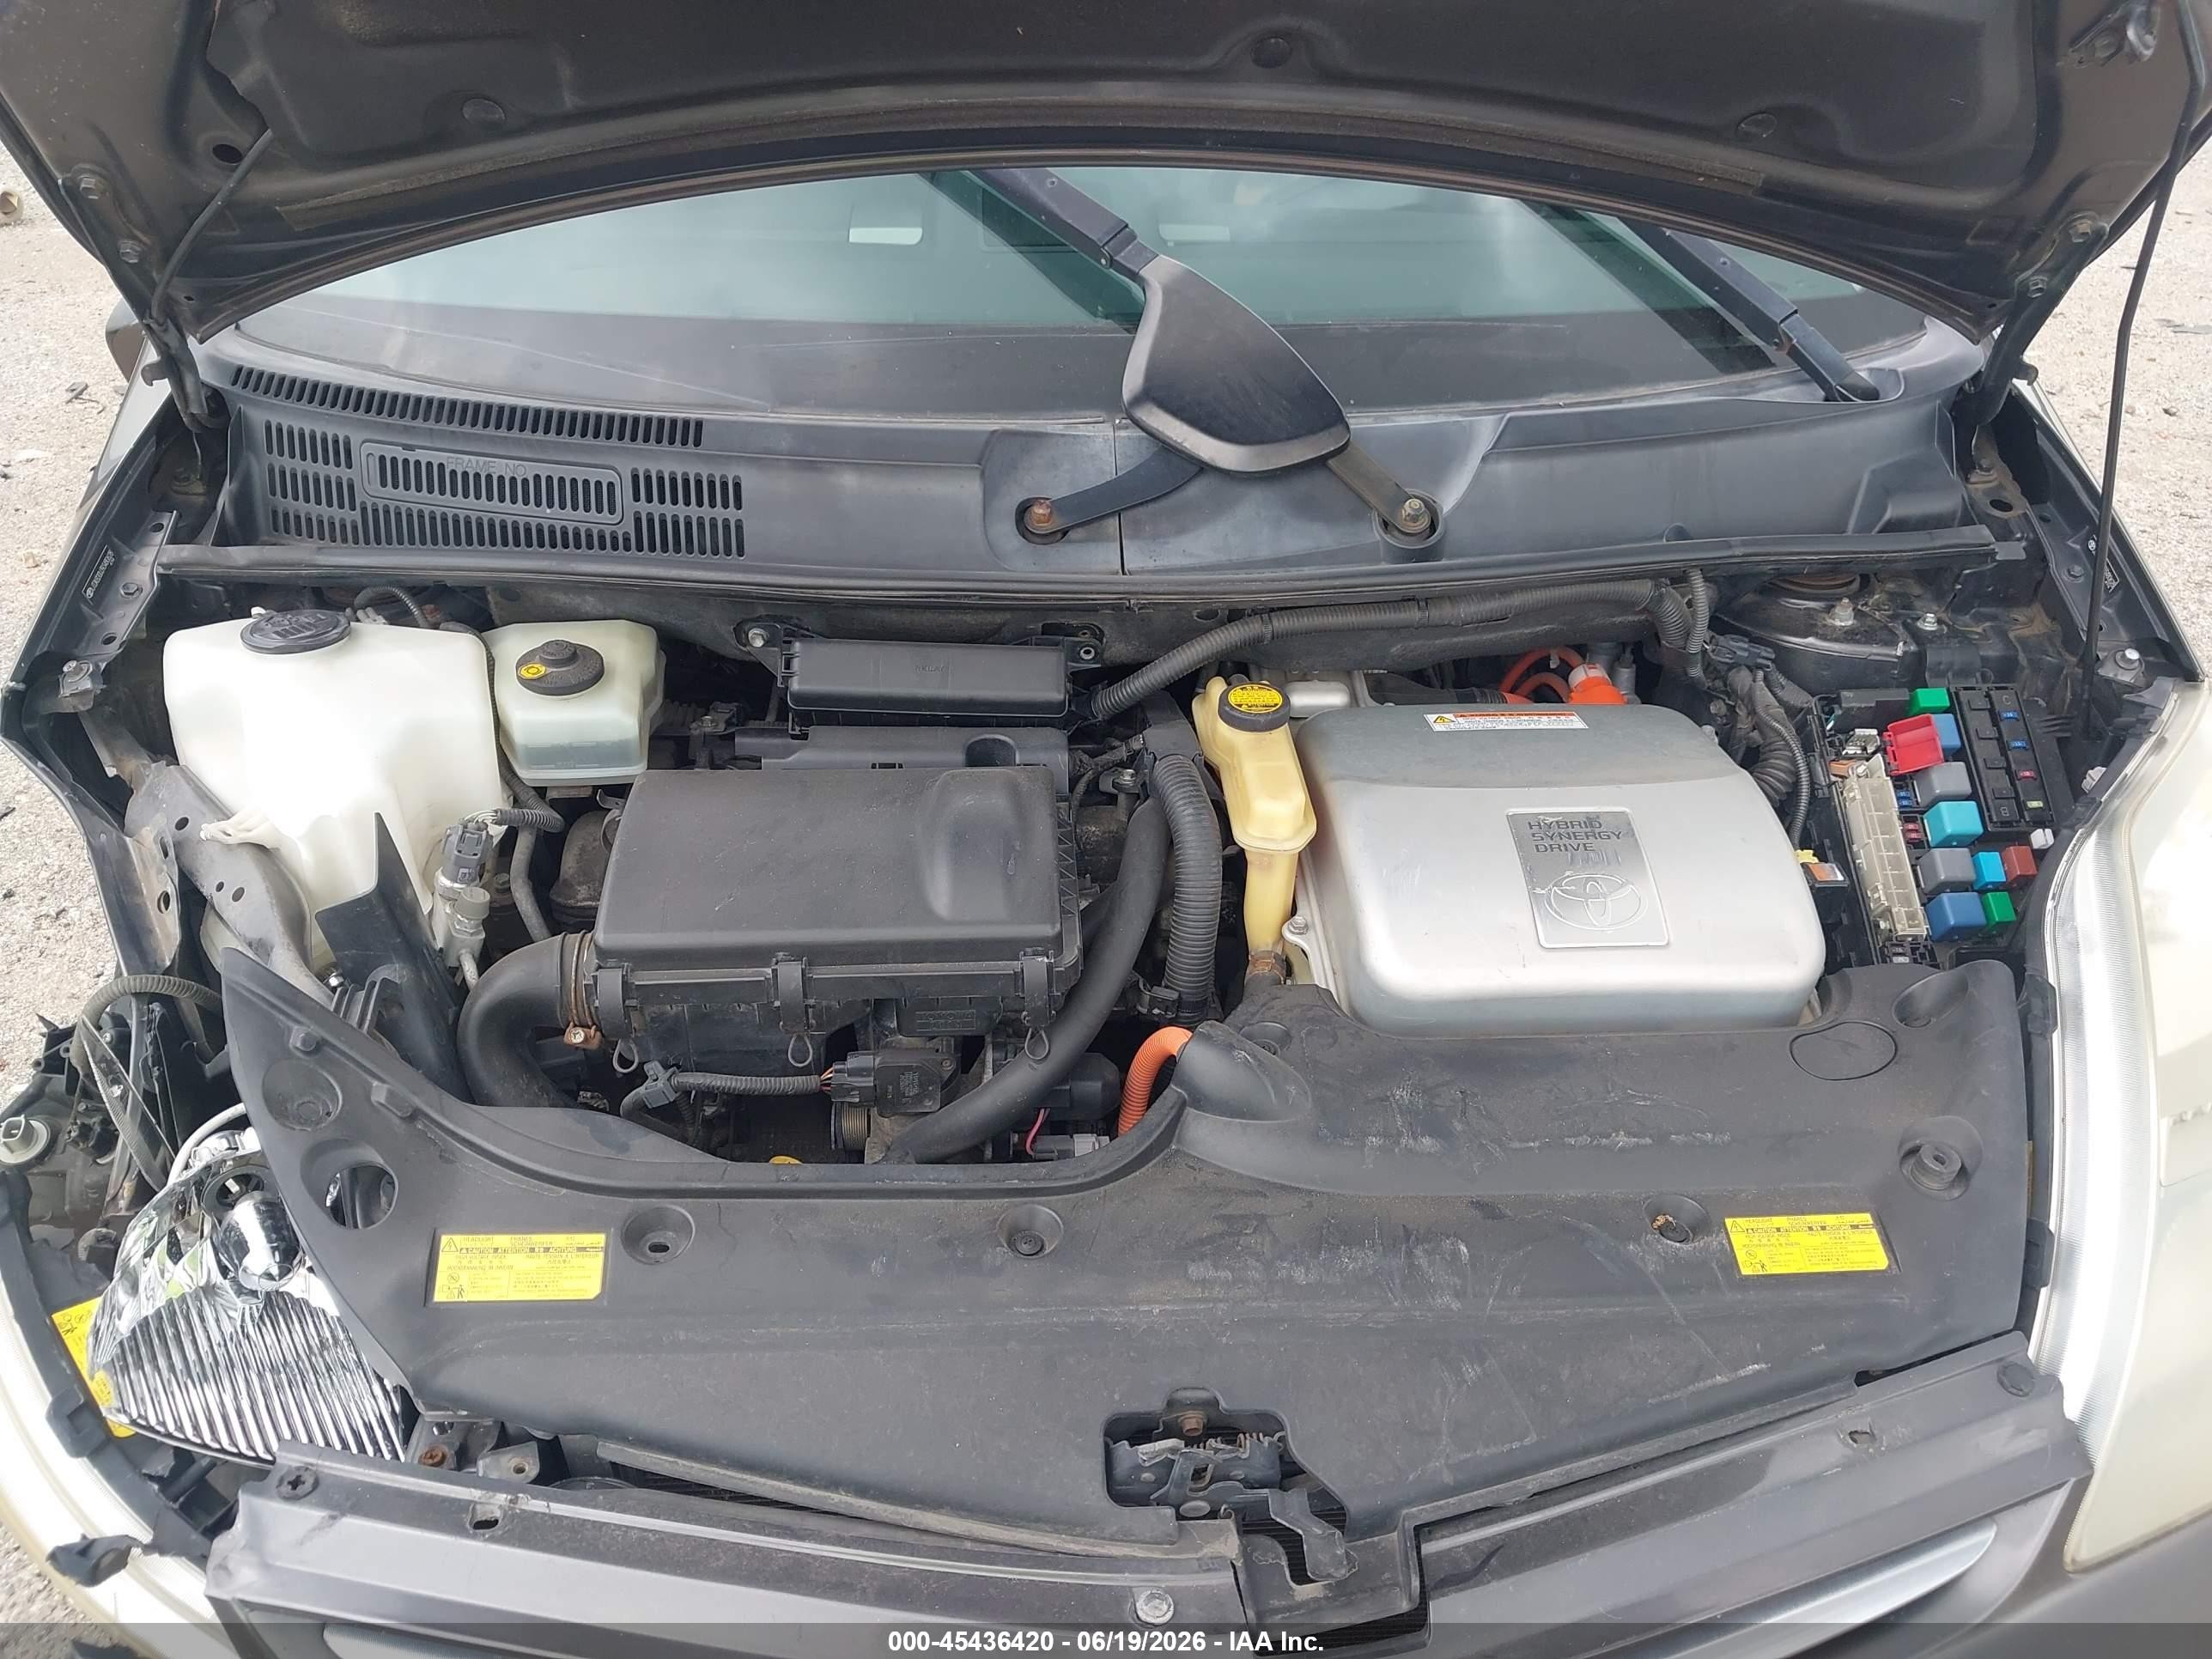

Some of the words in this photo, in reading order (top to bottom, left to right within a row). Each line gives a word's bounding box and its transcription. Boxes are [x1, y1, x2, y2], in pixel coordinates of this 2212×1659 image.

[447, 456, 496, 475] FRAME
[1528, 820, 1603, 830] HYBRID
[1532, 830, 1622, 842] SYNERGY
[1534, 842, 1596, 853] DRIVE
